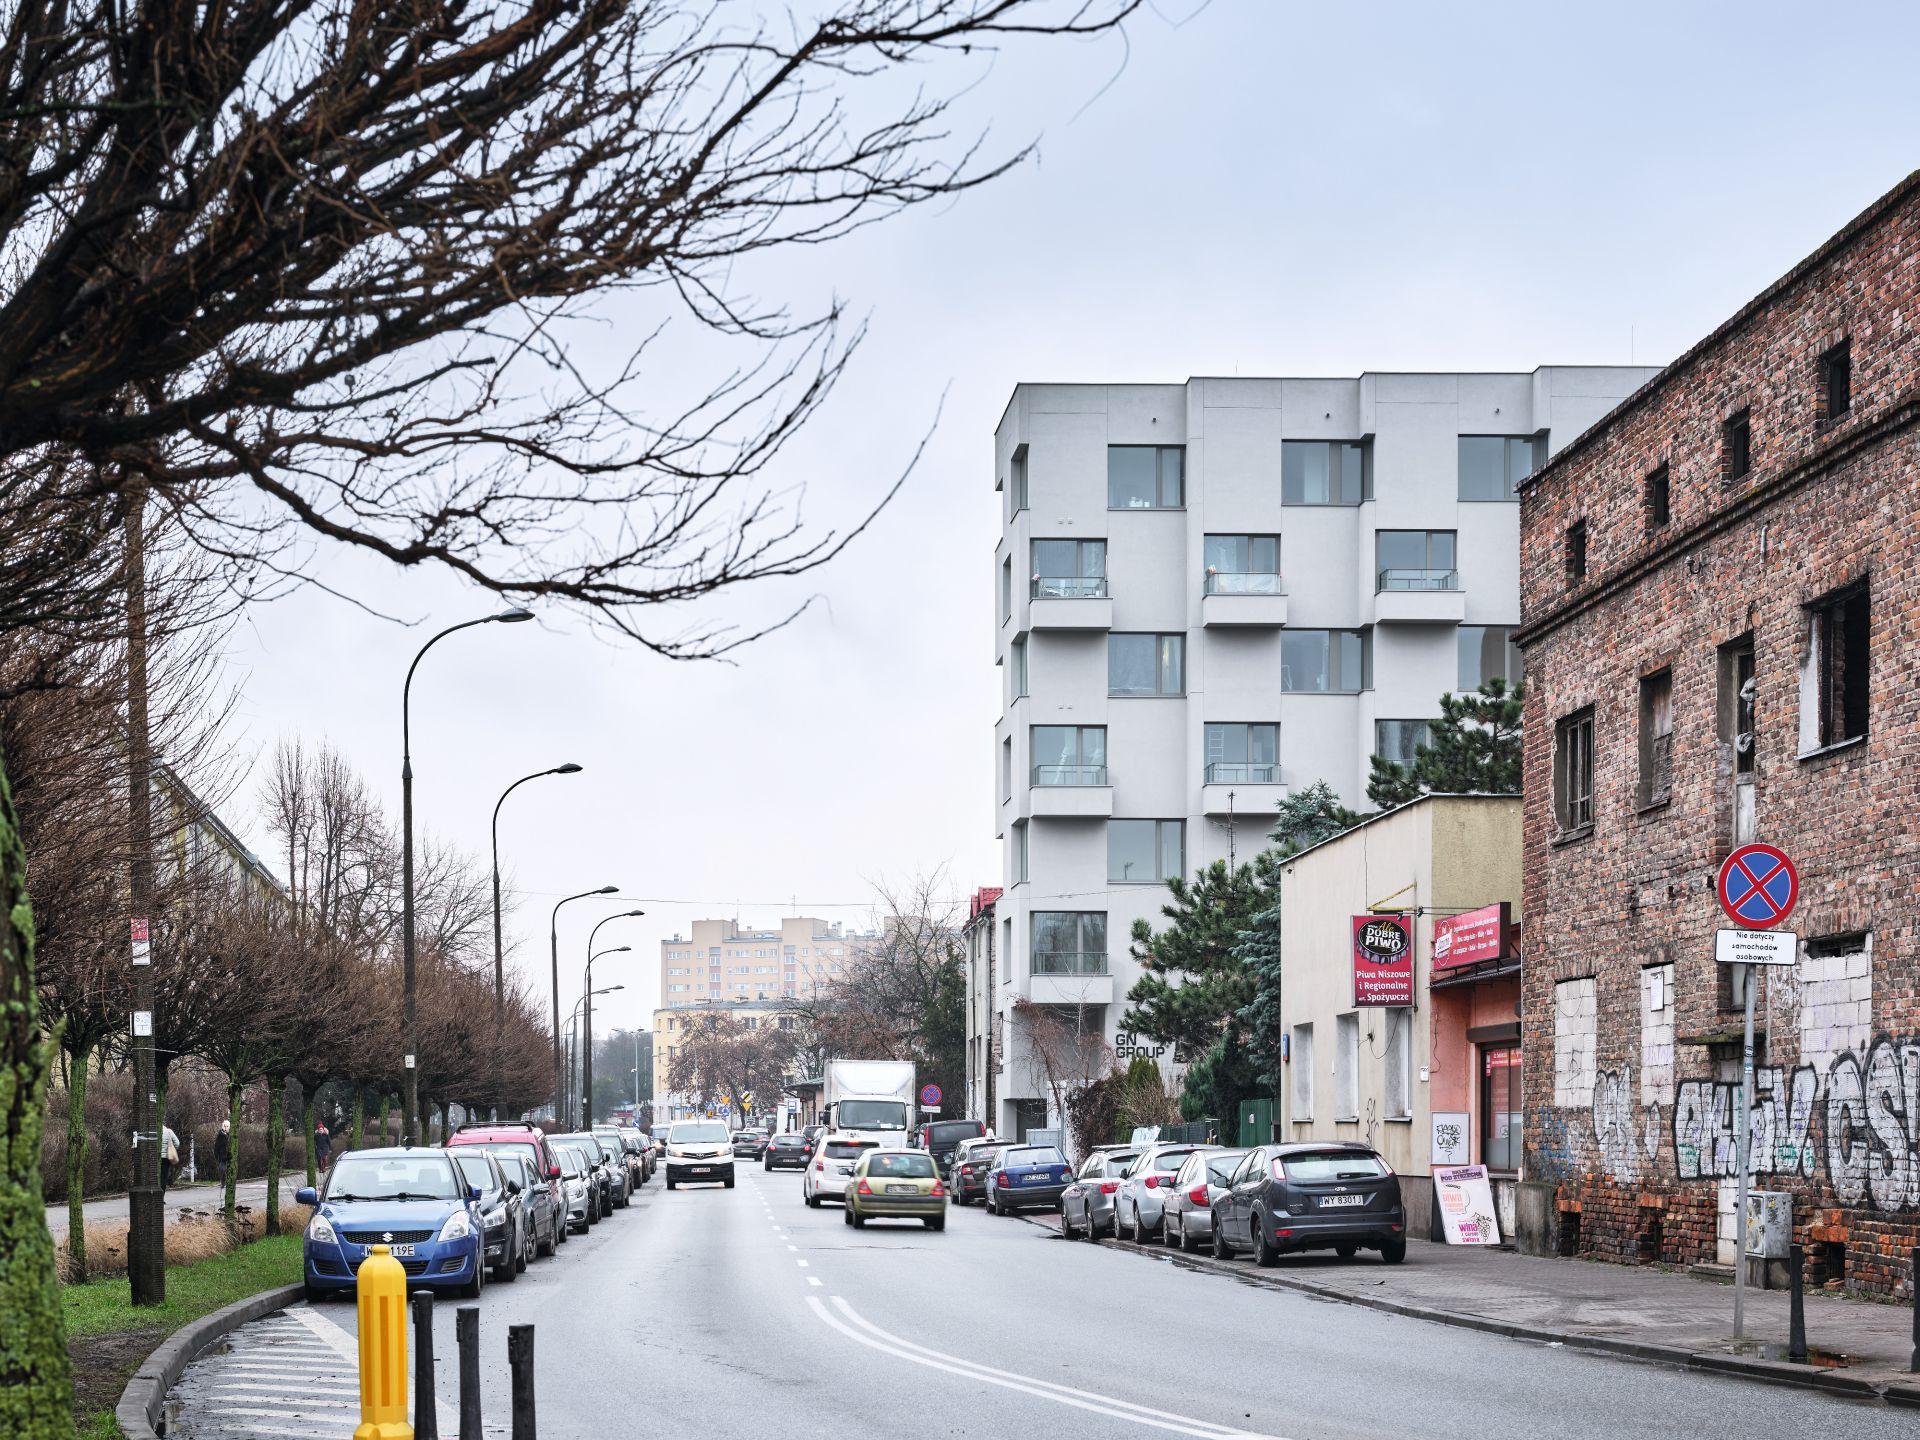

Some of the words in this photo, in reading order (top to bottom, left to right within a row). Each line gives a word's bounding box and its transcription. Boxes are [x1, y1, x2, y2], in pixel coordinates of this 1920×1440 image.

[1366, 928, 1401, 940] DOBRE
[1736, 931, 1748, 939] Nie
[1749, 932, 1774, 941] dotyczy
[1365, 935, 1402, 950] PIWO
[1736, 954, 1773, 962] osobowych
[1356, 970, 1376, 979] Piwa
[1378, 970, 1411, 979] Niszowe
[1364, 981, 1408, 992] Regionalne
[1367, 992, 1409, 1003] Spożywcze
[1115, 1034, 1137, 1046] GN
[1115, 1046, 1165, 1059] GROUP
[1324, 1196, 1335, 1205] WY
[1338, 1195, 1362, 1205] 8301J
[1458, 1222, 1478, 1232] wina
